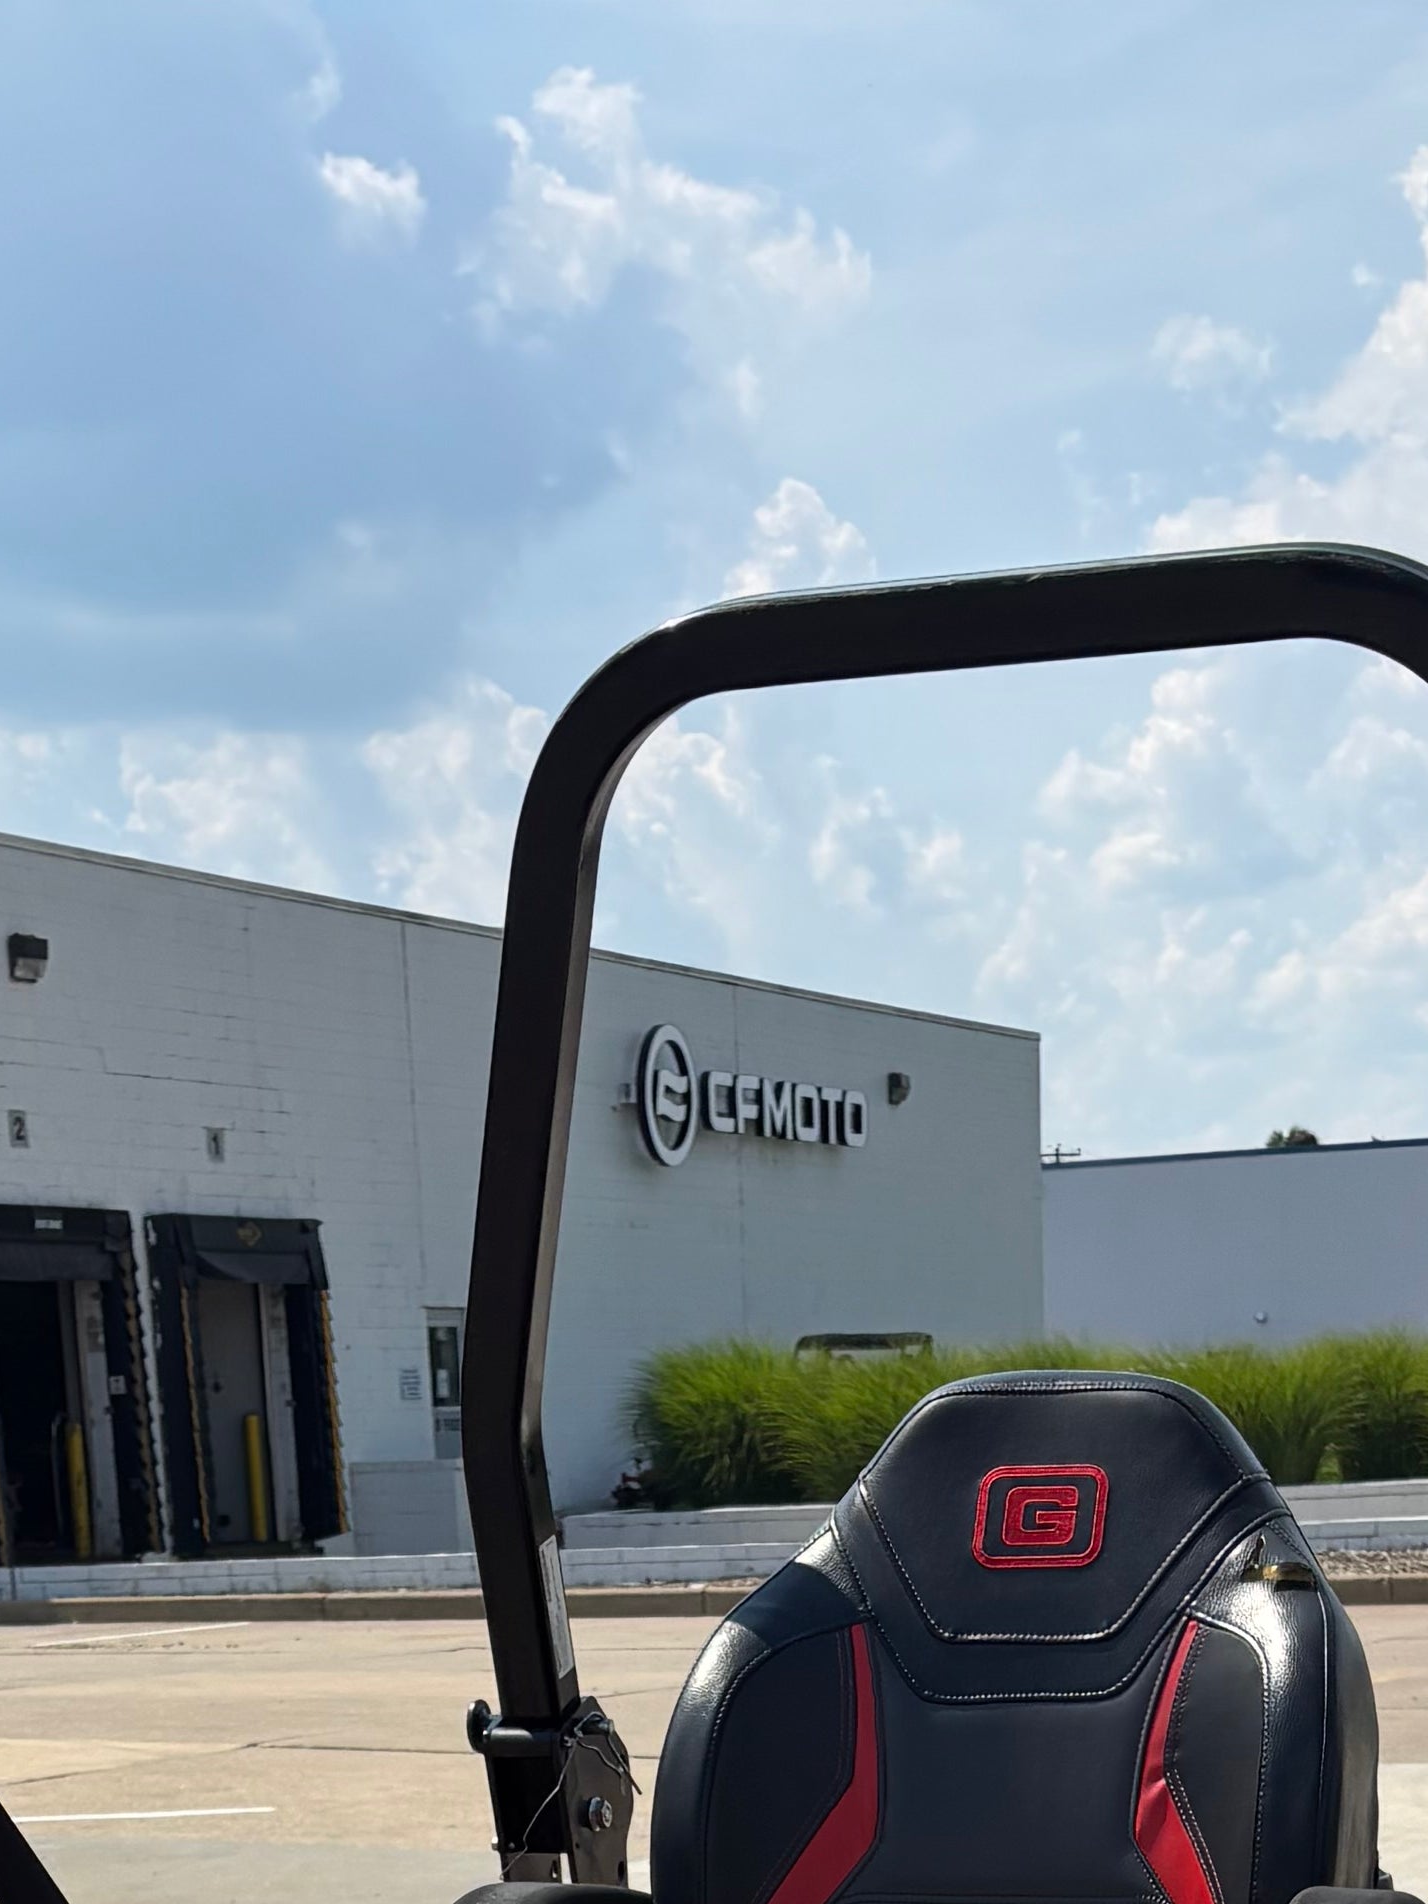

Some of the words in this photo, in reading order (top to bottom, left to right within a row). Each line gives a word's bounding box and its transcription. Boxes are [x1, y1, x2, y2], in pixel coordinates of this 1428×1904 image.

[12, 1116, 27, 1141] 2
[702, 1070, 868, 1147] CFMOTO
[1002, 1486, 1078, 1545] G
